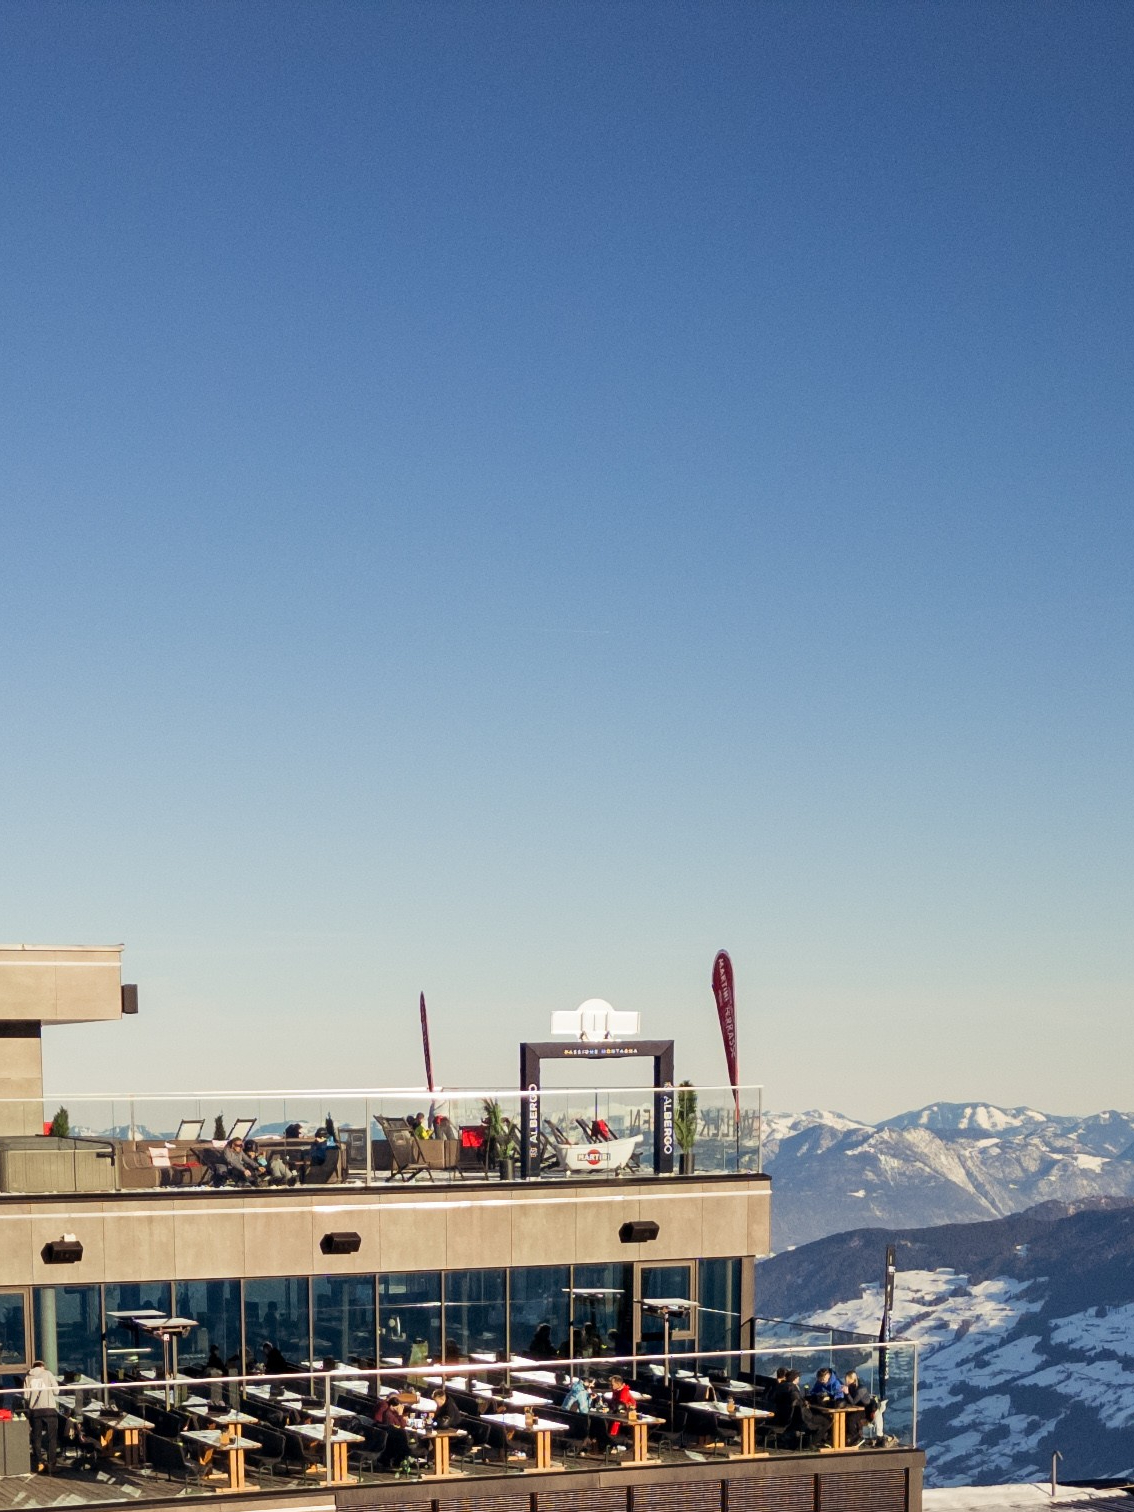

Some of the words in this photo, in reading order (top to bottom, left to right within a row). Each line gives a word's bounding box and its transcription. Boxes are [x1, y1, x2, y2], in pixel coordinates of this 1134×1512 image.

[718, 958, 729, 1002] MARTINI
[528, 1083, 538, 1143] ALBERGO
[663, 1096, 673, 1155] ALBERGO
